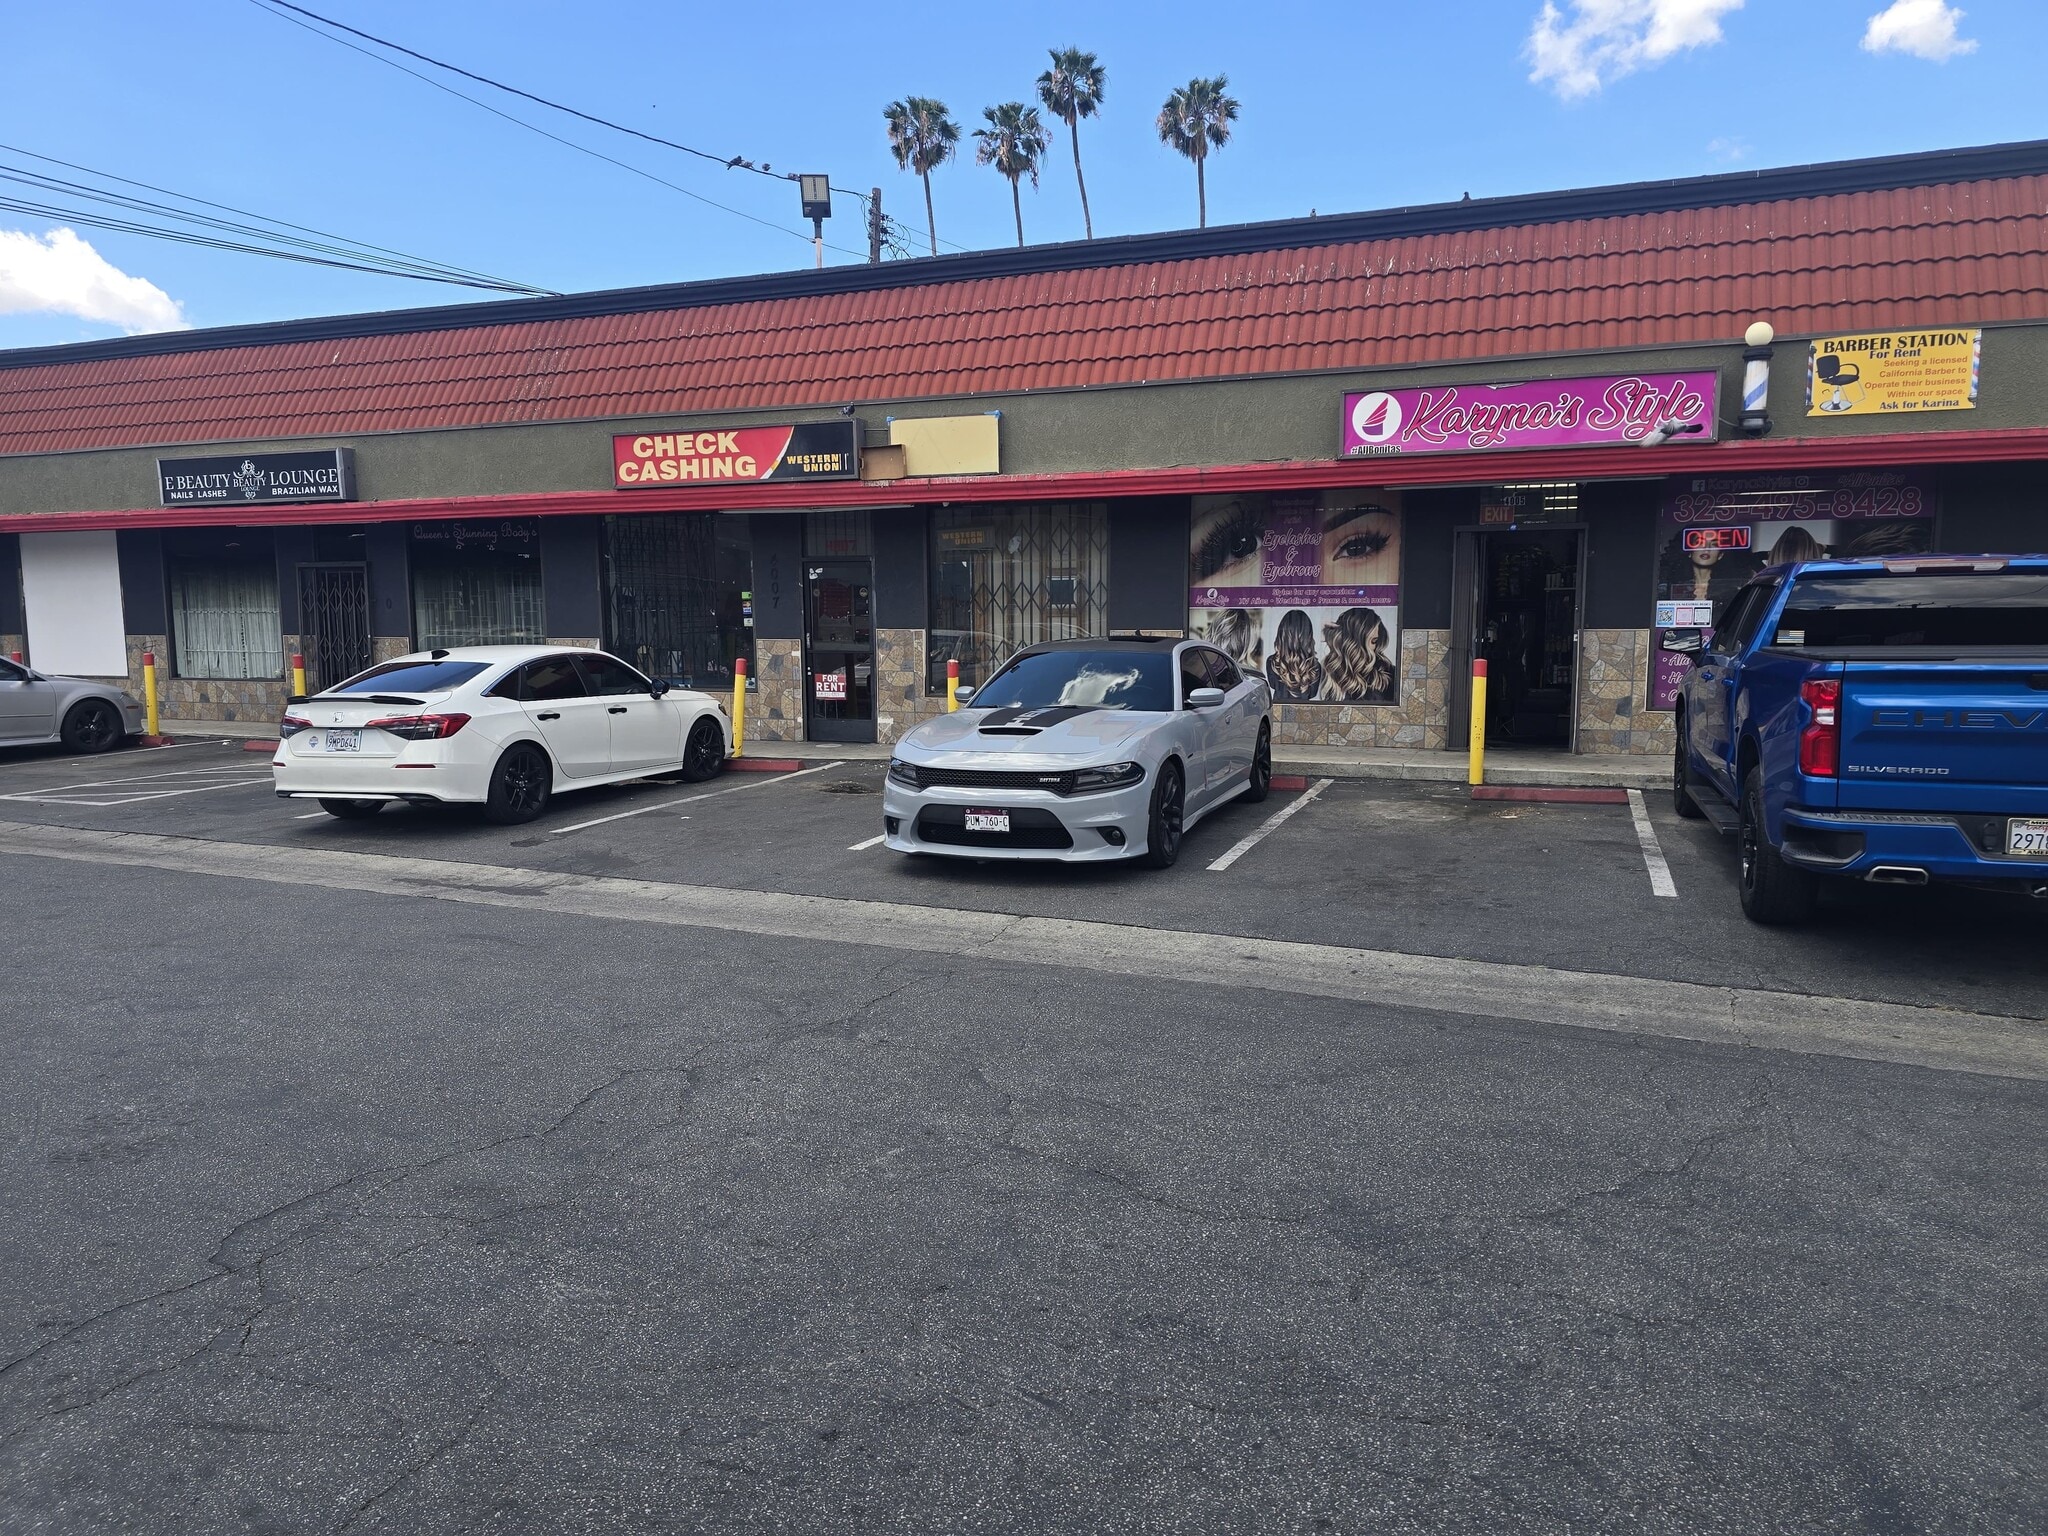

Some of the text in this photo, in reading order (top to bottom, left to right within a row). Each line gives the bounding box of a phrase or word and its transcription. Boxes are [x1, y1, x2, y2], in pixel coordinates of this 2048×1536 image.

[1823, 332, 1968, 353] BARBER STATION
[1869, 349, 1921, 360] For Rent
[1883, 359, 1920, 368] Seeking
[1929, 356, 1968, 365] licensed
[1879, 366, 1967, 378] California Barber to
[1864, 377, 1966, 390] Operate their business
[1887, 388, 1966, 398] Within our space.
[1879, 399, 1959, 410] Ask for Karina
[1402, 378, 1704, 449] Karyna's Style
[632, 431, 741, 458] CHECK
[786, 453, 839, 465] WESTERN
[618, 456, 757, 482] CASHING
[803, 462, 840, 473] UNION
[164, 468, 338, 490] E BEAUTY LOUNGE
[233, 477, 267, 488] BEAUTY
[171, 485, 339, 499] NAILS LASHES BRAZILIAN WAX
[1673, 486, 1922, 523] 323-495-8428
[1484, 506, 1511, 522] EXIT
[941, 530, 983, 540] WESTERN
[955, 537, 983, 545] UNION
[1262, 527, 1323, 551] Eyelashes
[1686, 529, 1748, 549] OPEN
[1285, 546, 1298, 561] &
[1262, 560, 1321, 583] Eyebrows
[1293, 588, 1304, 596] for
[1304, 589, 1319, 597] any
[1275, 597, 1311, 606] Weddings
[1348, 596, 1370, 604] much
[822, 674, 838, 682] FOR
[816, 682, 845, 692] RENT
[1872, 711, 2048, 729] CHEV
[328, 736, 357, 748] 9MPD641
[1848, 765, 1950, 775] SILVERADO
